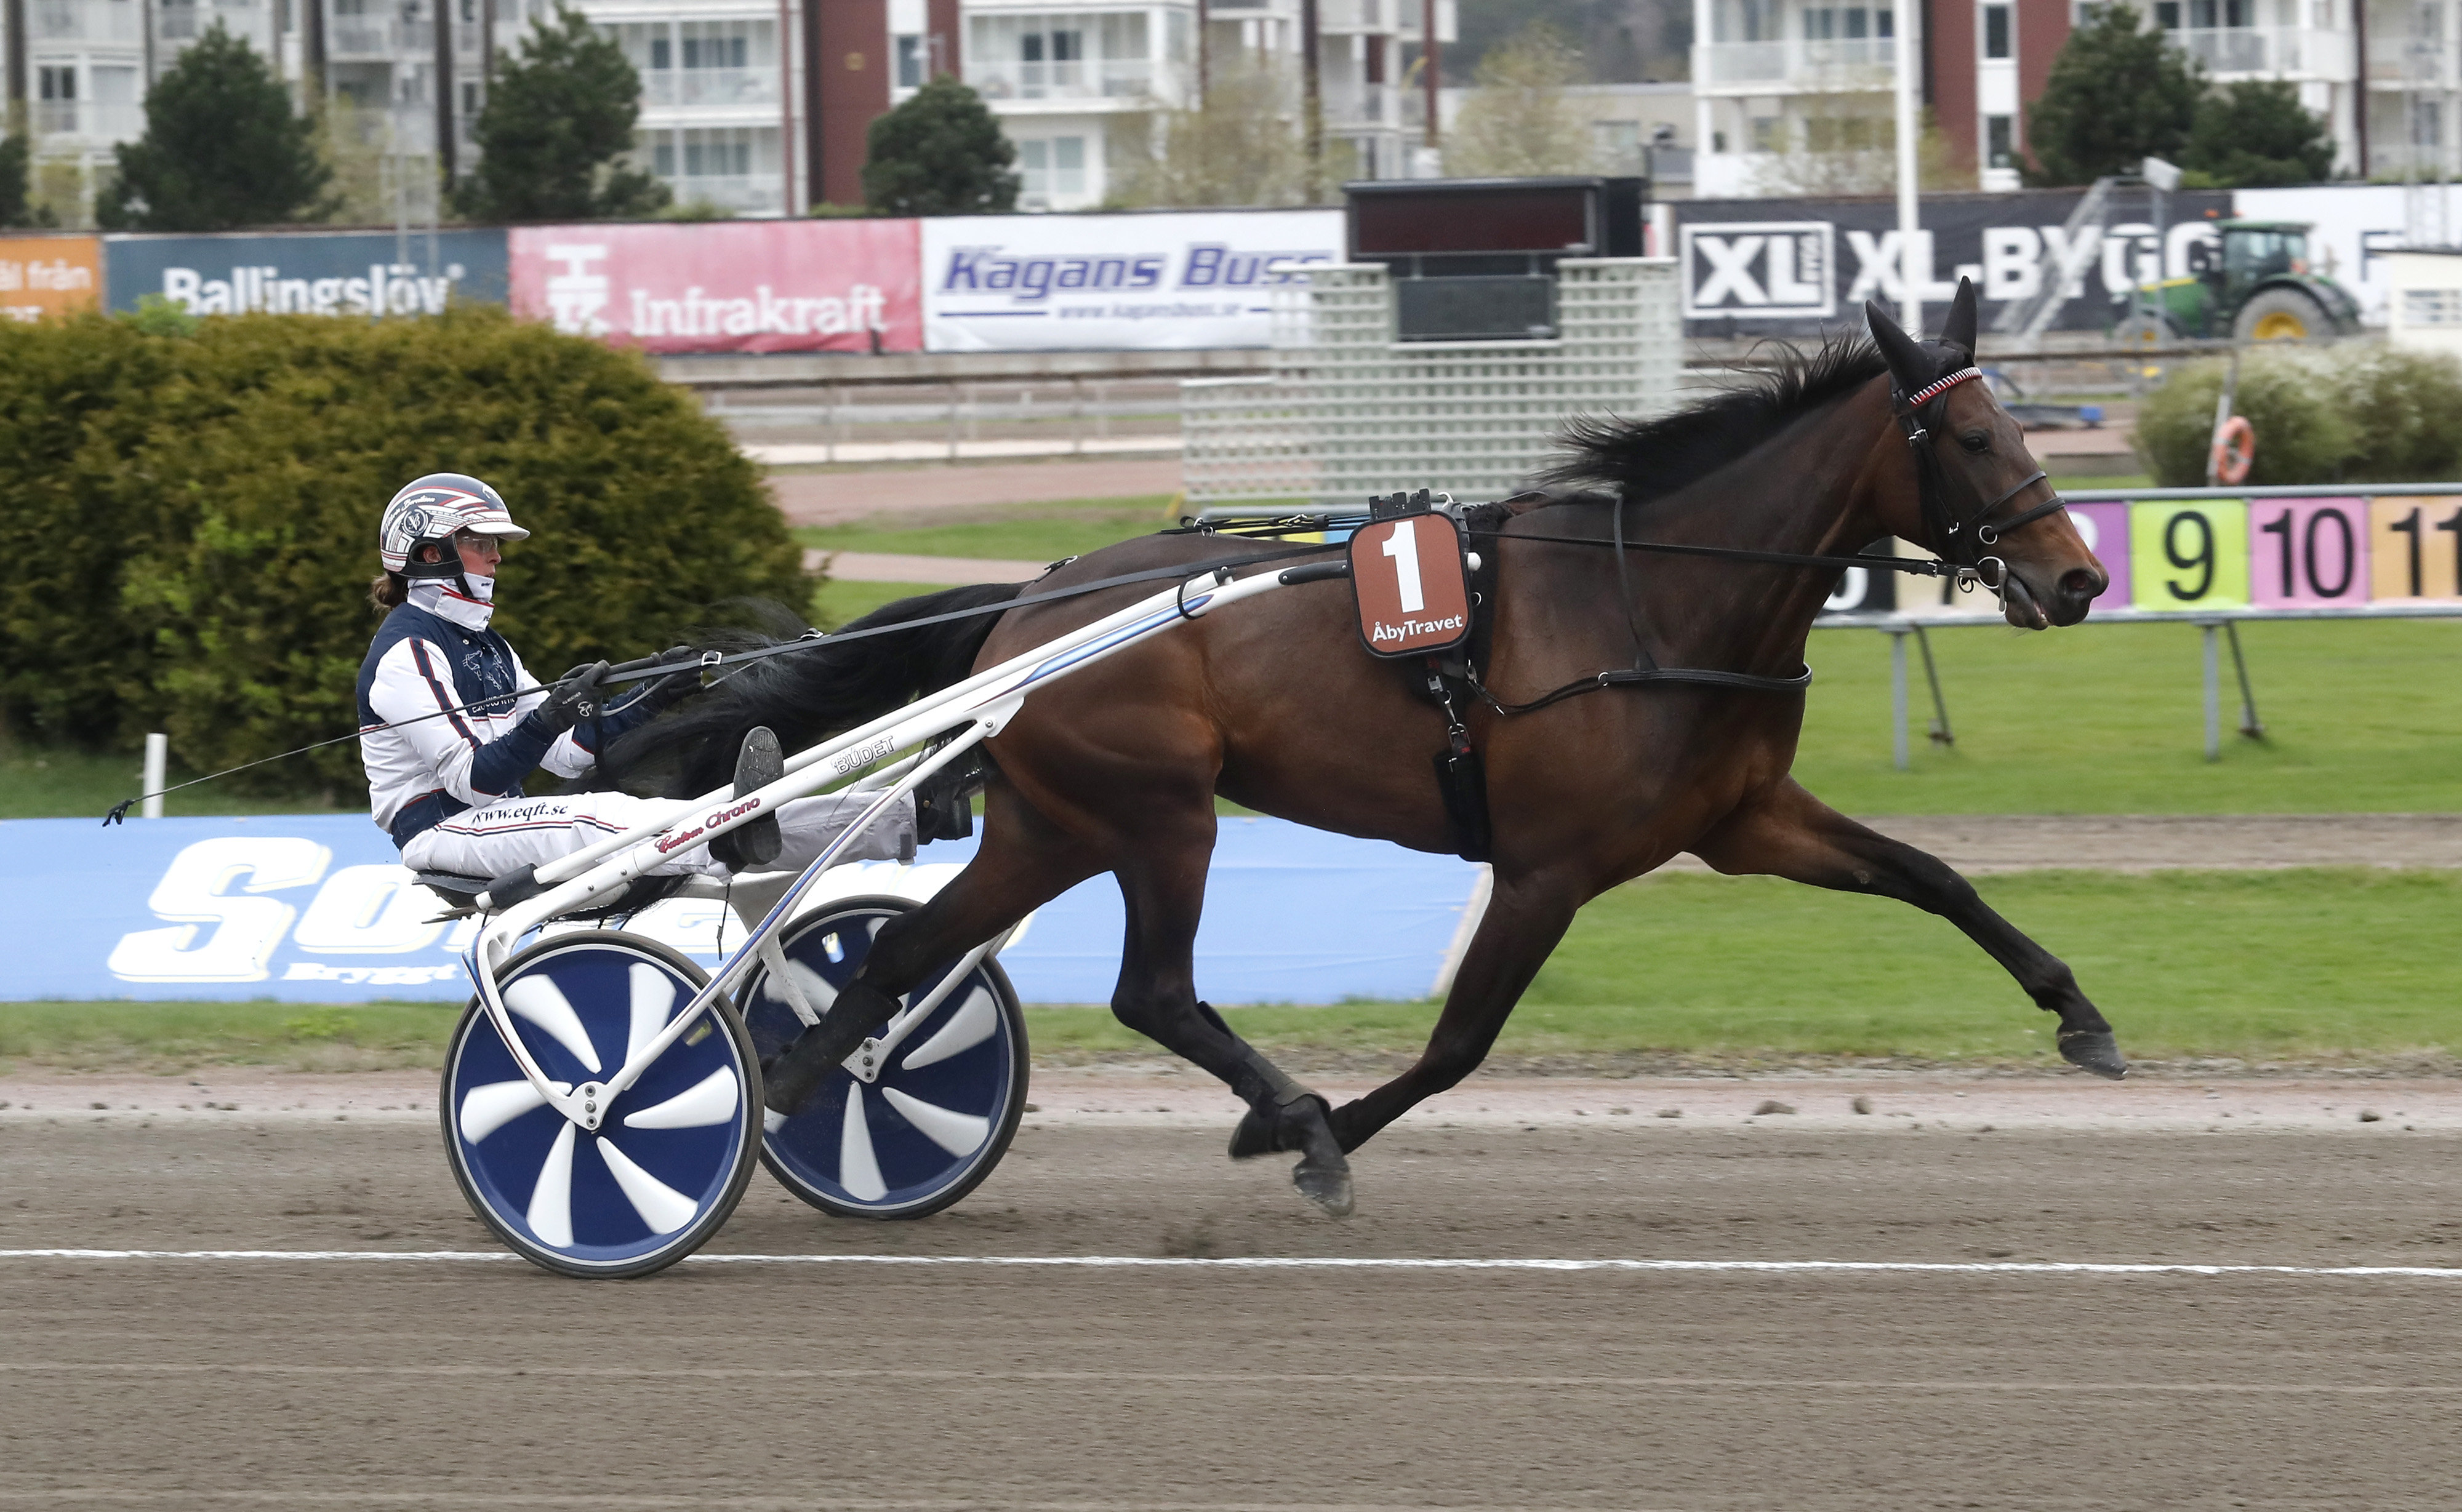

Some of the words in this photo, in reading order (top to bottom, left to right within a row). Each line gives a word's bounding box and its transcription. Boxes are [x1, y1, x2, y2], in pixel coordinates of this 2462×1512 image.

[162, 263, 452, 315] Ballingslöv
[938, 245, 1167, 303] Kagans
[1693, 234, 1823, 307] XL
[629, 284, 888, 335] Infrakraft
[1382, 520, 1424, 613] 1
[2165, 510, 2217, 601] 9
[2261, 508, 2355, 599] 10
[1372, 614, 1463, 642] ÅbyTravet
[836, 735, 894, 775] BUDET
[705, 798, 761, 829] Chrono
[280, 962, 460, 985] Bryggt
